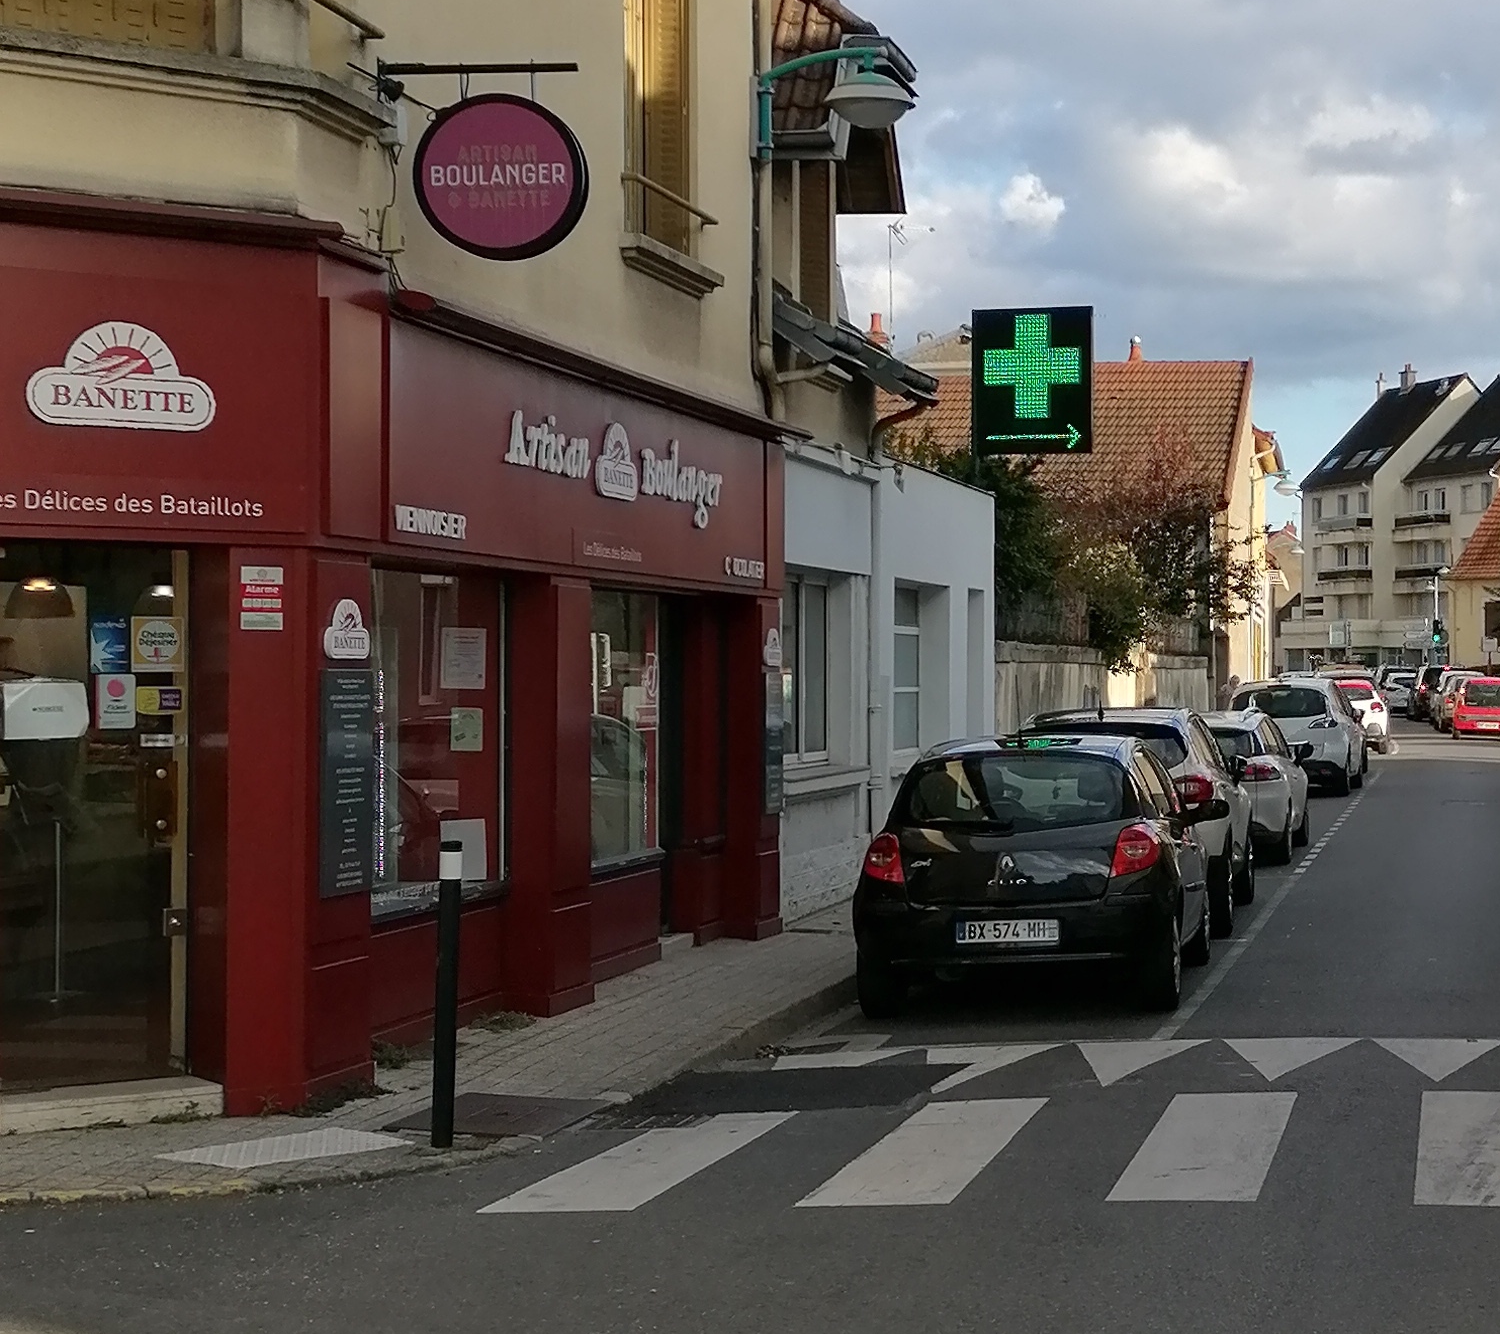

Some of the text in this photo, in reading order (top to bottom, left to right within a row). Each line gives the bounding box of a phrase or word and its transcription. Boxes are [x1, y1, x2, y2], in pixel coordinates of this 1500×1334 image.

[458, 144, 538, 163] ARTISAN
[430, 162, 566, 186] BOULANGER
[468, 188, 550, 208] BANETTE
[50, 383, 196, 415] BANETTE
[505, 410, 723, 529] Artisan Boulanger
[603, 466, 635, 490] BANETTE
[24, 489, 108, 513] Délices
[113, 493, 153, 514] des
[160, 494, 264, 517] Bataillots
[333, 637, 366, 650] BANETTE
